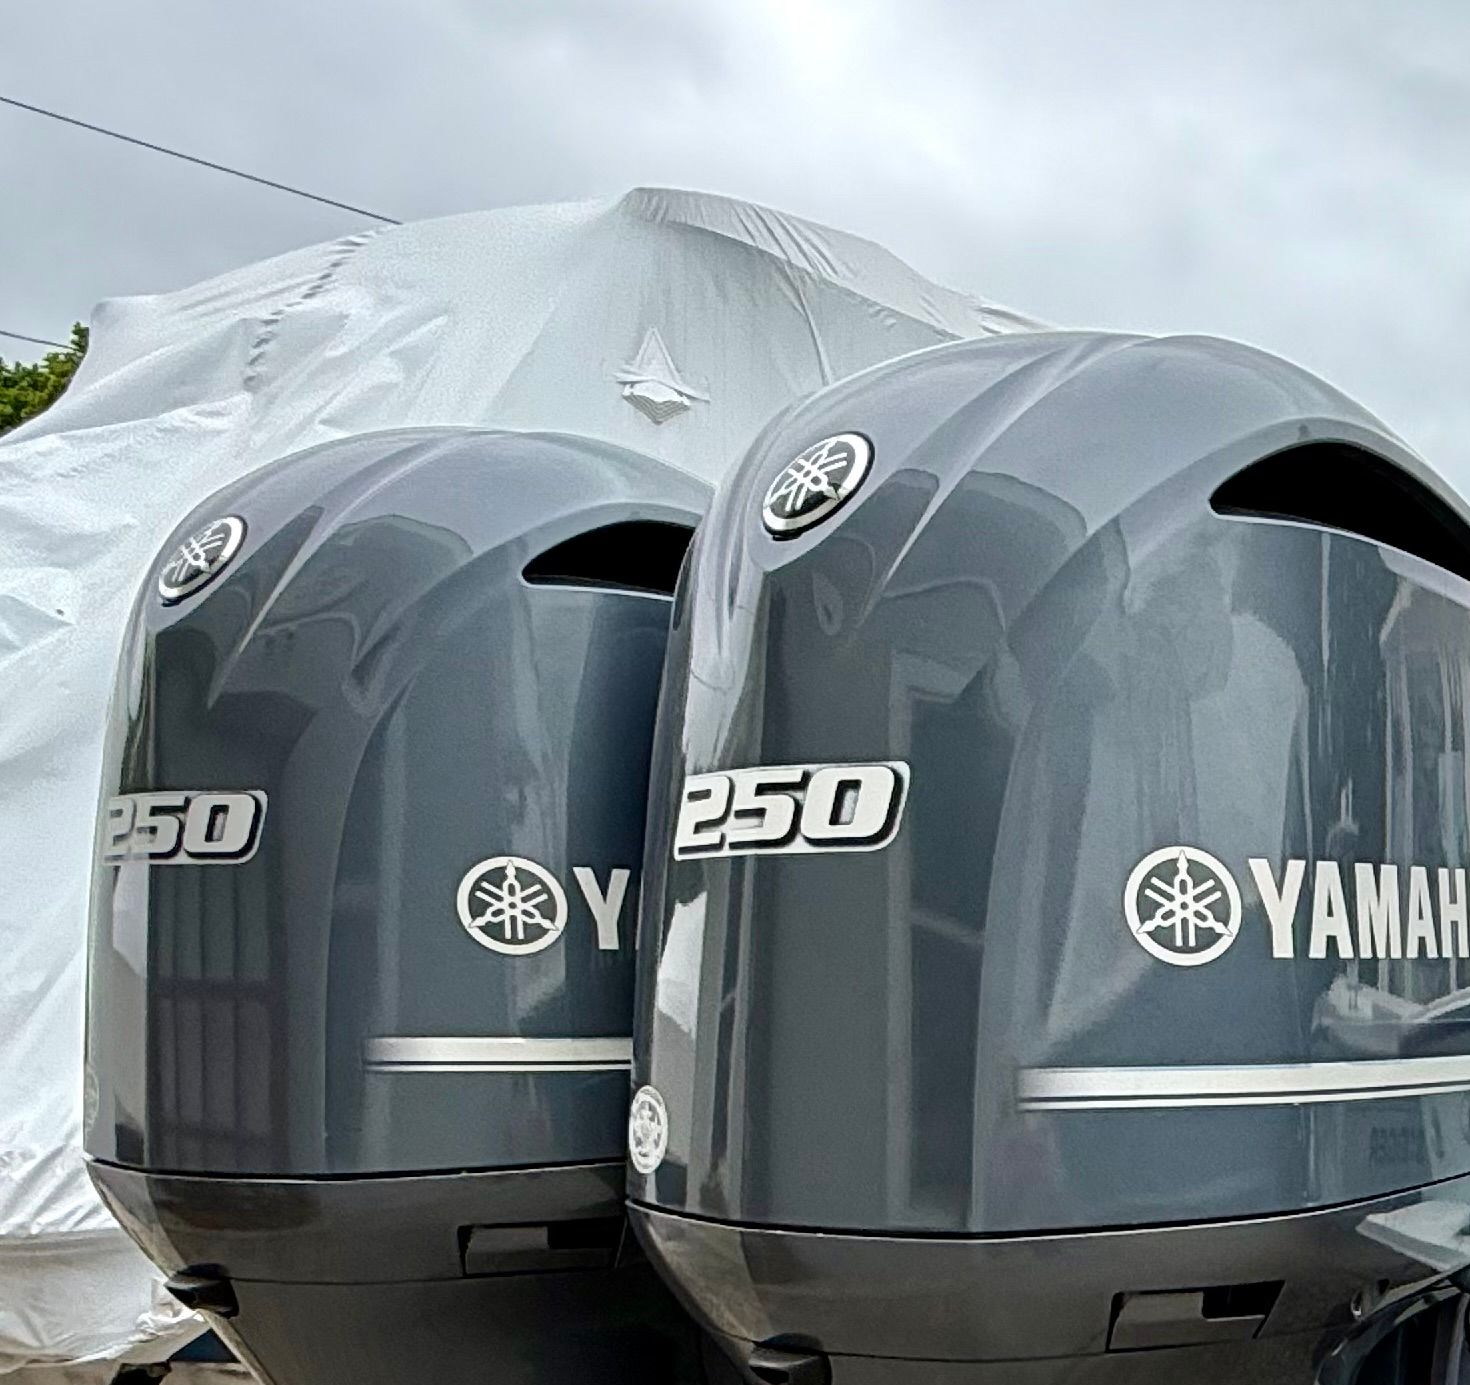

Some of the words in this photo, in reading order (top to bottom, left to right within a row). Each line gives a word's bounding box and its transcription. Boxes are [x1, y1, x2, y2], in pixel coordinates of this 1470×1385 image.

[103, 795, 256, 859] 250
[678, 766, 899, 852] 250
[572, 866, 644, 950] Y
